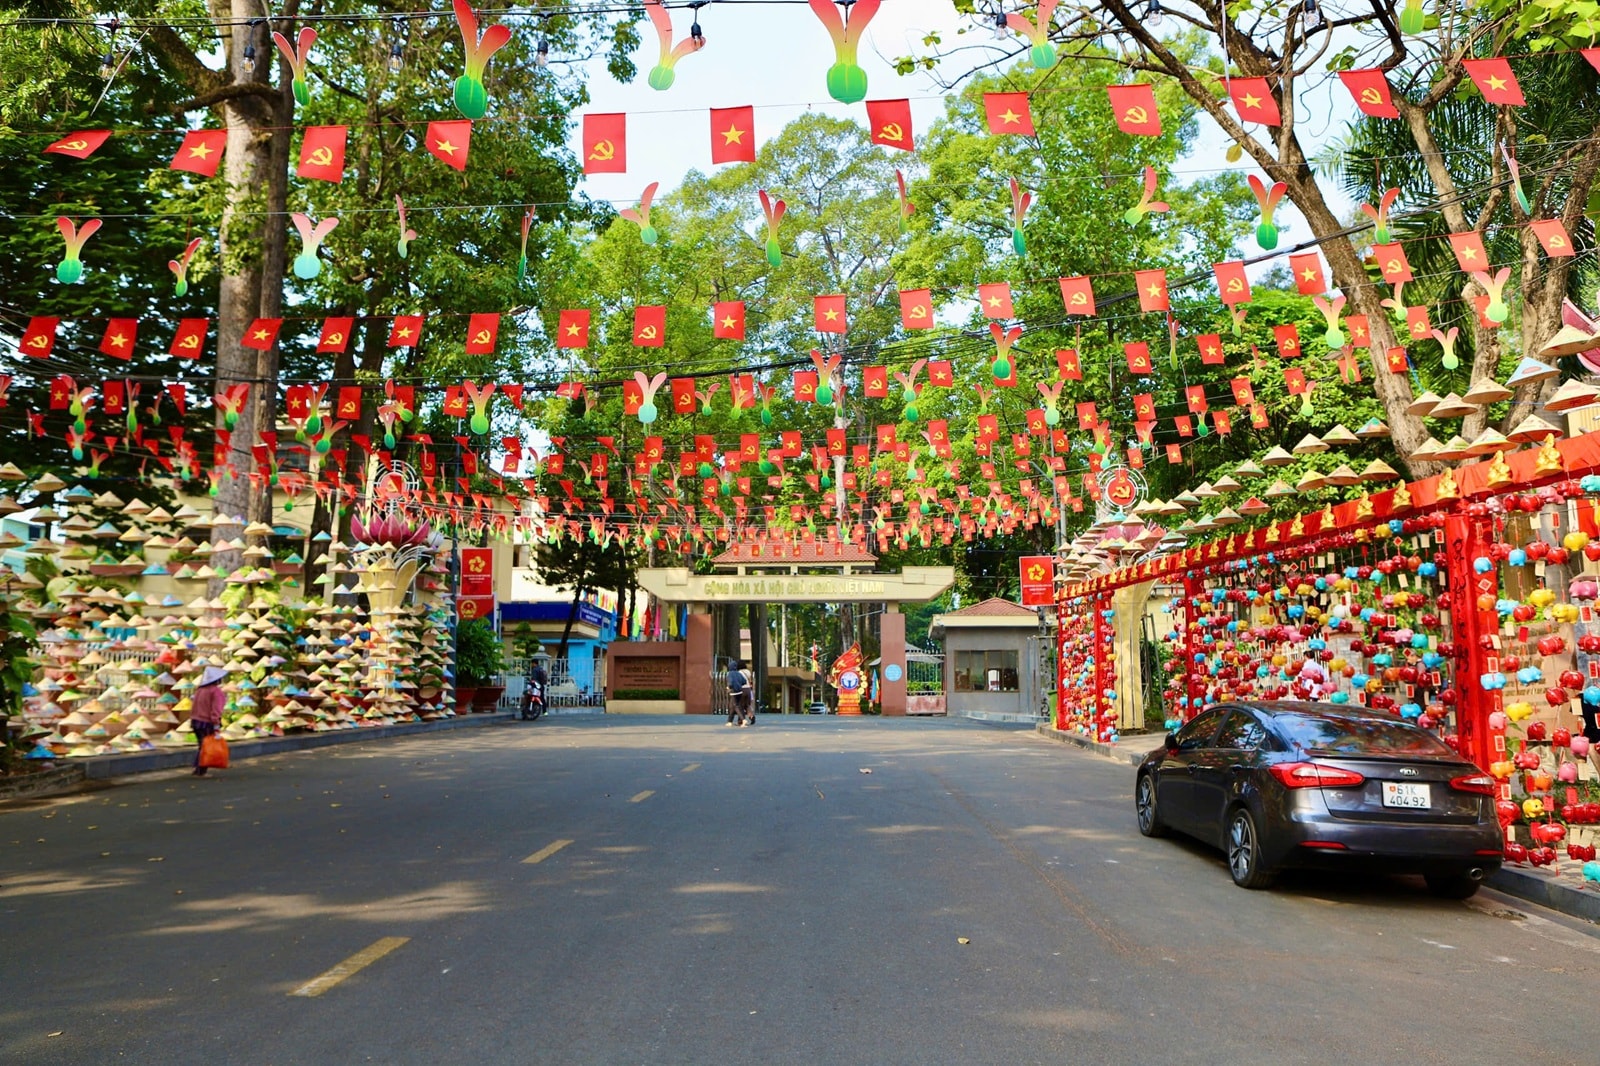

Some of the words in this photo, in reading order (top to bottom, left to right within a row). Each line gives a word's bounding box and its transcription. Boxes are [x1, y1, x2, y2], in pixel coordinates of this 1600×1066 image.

[753, 580, 766, 595] XÃ
[861, 580, 884, 595] NAM
[1402, 768, 1417, 776] KIA
[1397, 785, 1417, 795] 61K
[1390, 795, 1426, 807] 404.92
